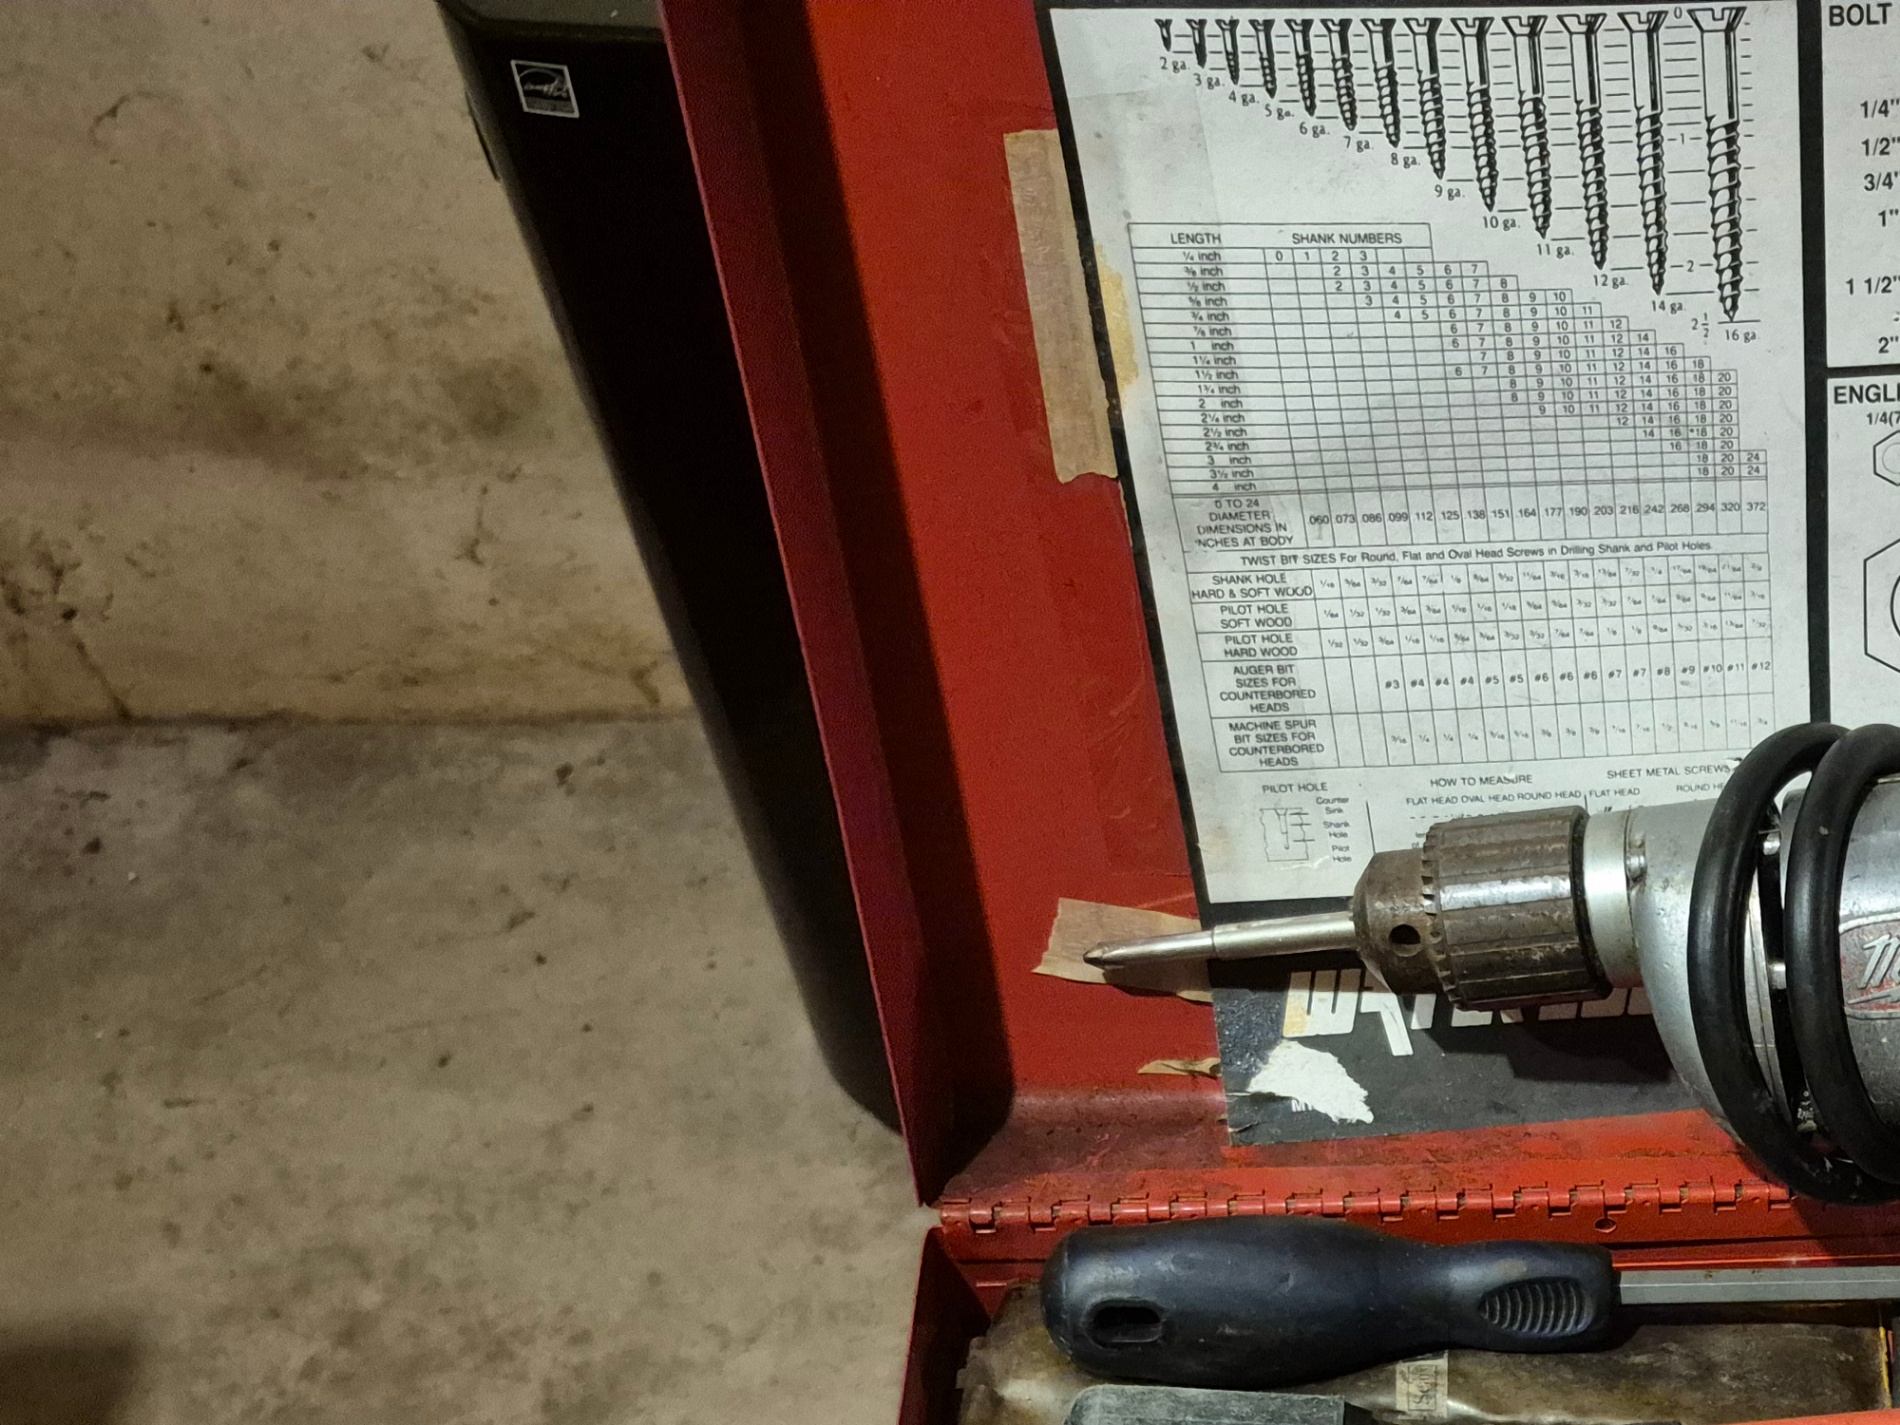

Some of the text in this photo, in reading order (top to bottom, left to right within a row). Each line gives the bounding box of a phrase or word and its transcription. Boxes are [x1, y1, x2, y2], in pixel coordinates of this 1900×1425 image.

[1829, 4, 1892, 26] BOLT
[1159, 56, 1168, 70] 2
[1228, 90, 1237, 104] 4
[1860, 99, 1900, 118] 1/4"
[1390, 152, 1399, 166] 8
[1482, 215, 1499, 229] 10
[1170, 232, 1221, 245] LENGTH
[1292, 232, 1403, 245] SHANK NUMBERS
[1593, 273, 1608, 287] 12
[1725, 328, 1740, 341] 16
[1209, 510, 1270, 522] DIAMETER
[1197, 523, 1287, 535] DIMENSIONS IN
[1195, 535, 1293, 548] NCHES AT BODY
[1240, 554, 1277, 566] TWIST
[1281, 554, 1299, 565] BIT
[1303, 552, 1337, 564] SIZES
[1340, 552, 1357, 563] For
[1402, 549, 1422, 561] Flat
[1425, 549, 1445, 561] and
[1448, 548, 1472, 560] Oval
[1476, 547, 1503, 559] Head
[1507, 545, 1545, 558] Screws
[1548, 545, 1557, 555] in
[1561, 544, 1595, 557] Drilling
[1599, 542, 1630, 554] Shank
[1634, 542, 1654, 552] and
[1657, 541, 1680, 552] Pilot
[1212, 574, 1287, 585] SHANK HOLE
[1192, 585, 1313, 599] HARD & SOFT WOOD
[1220, 603, 1289, 615] PILOT HOLE
[1220, 617, 1292, 629] SOFT WOOD
[1233, 665, 1294, 675] AUGER BIT
[1235, 677, 1296, 688] SIZES FOR
[1220, 689, 1316, 701] COUNTERBORED
[1250, 702, 1290, 713] HEADS
[1607, 764, 1731, 780] SHEET METAL SCREWS
[1430, 777, 1457, 787] HOW
[1461, 777, 1476, 786] TO
